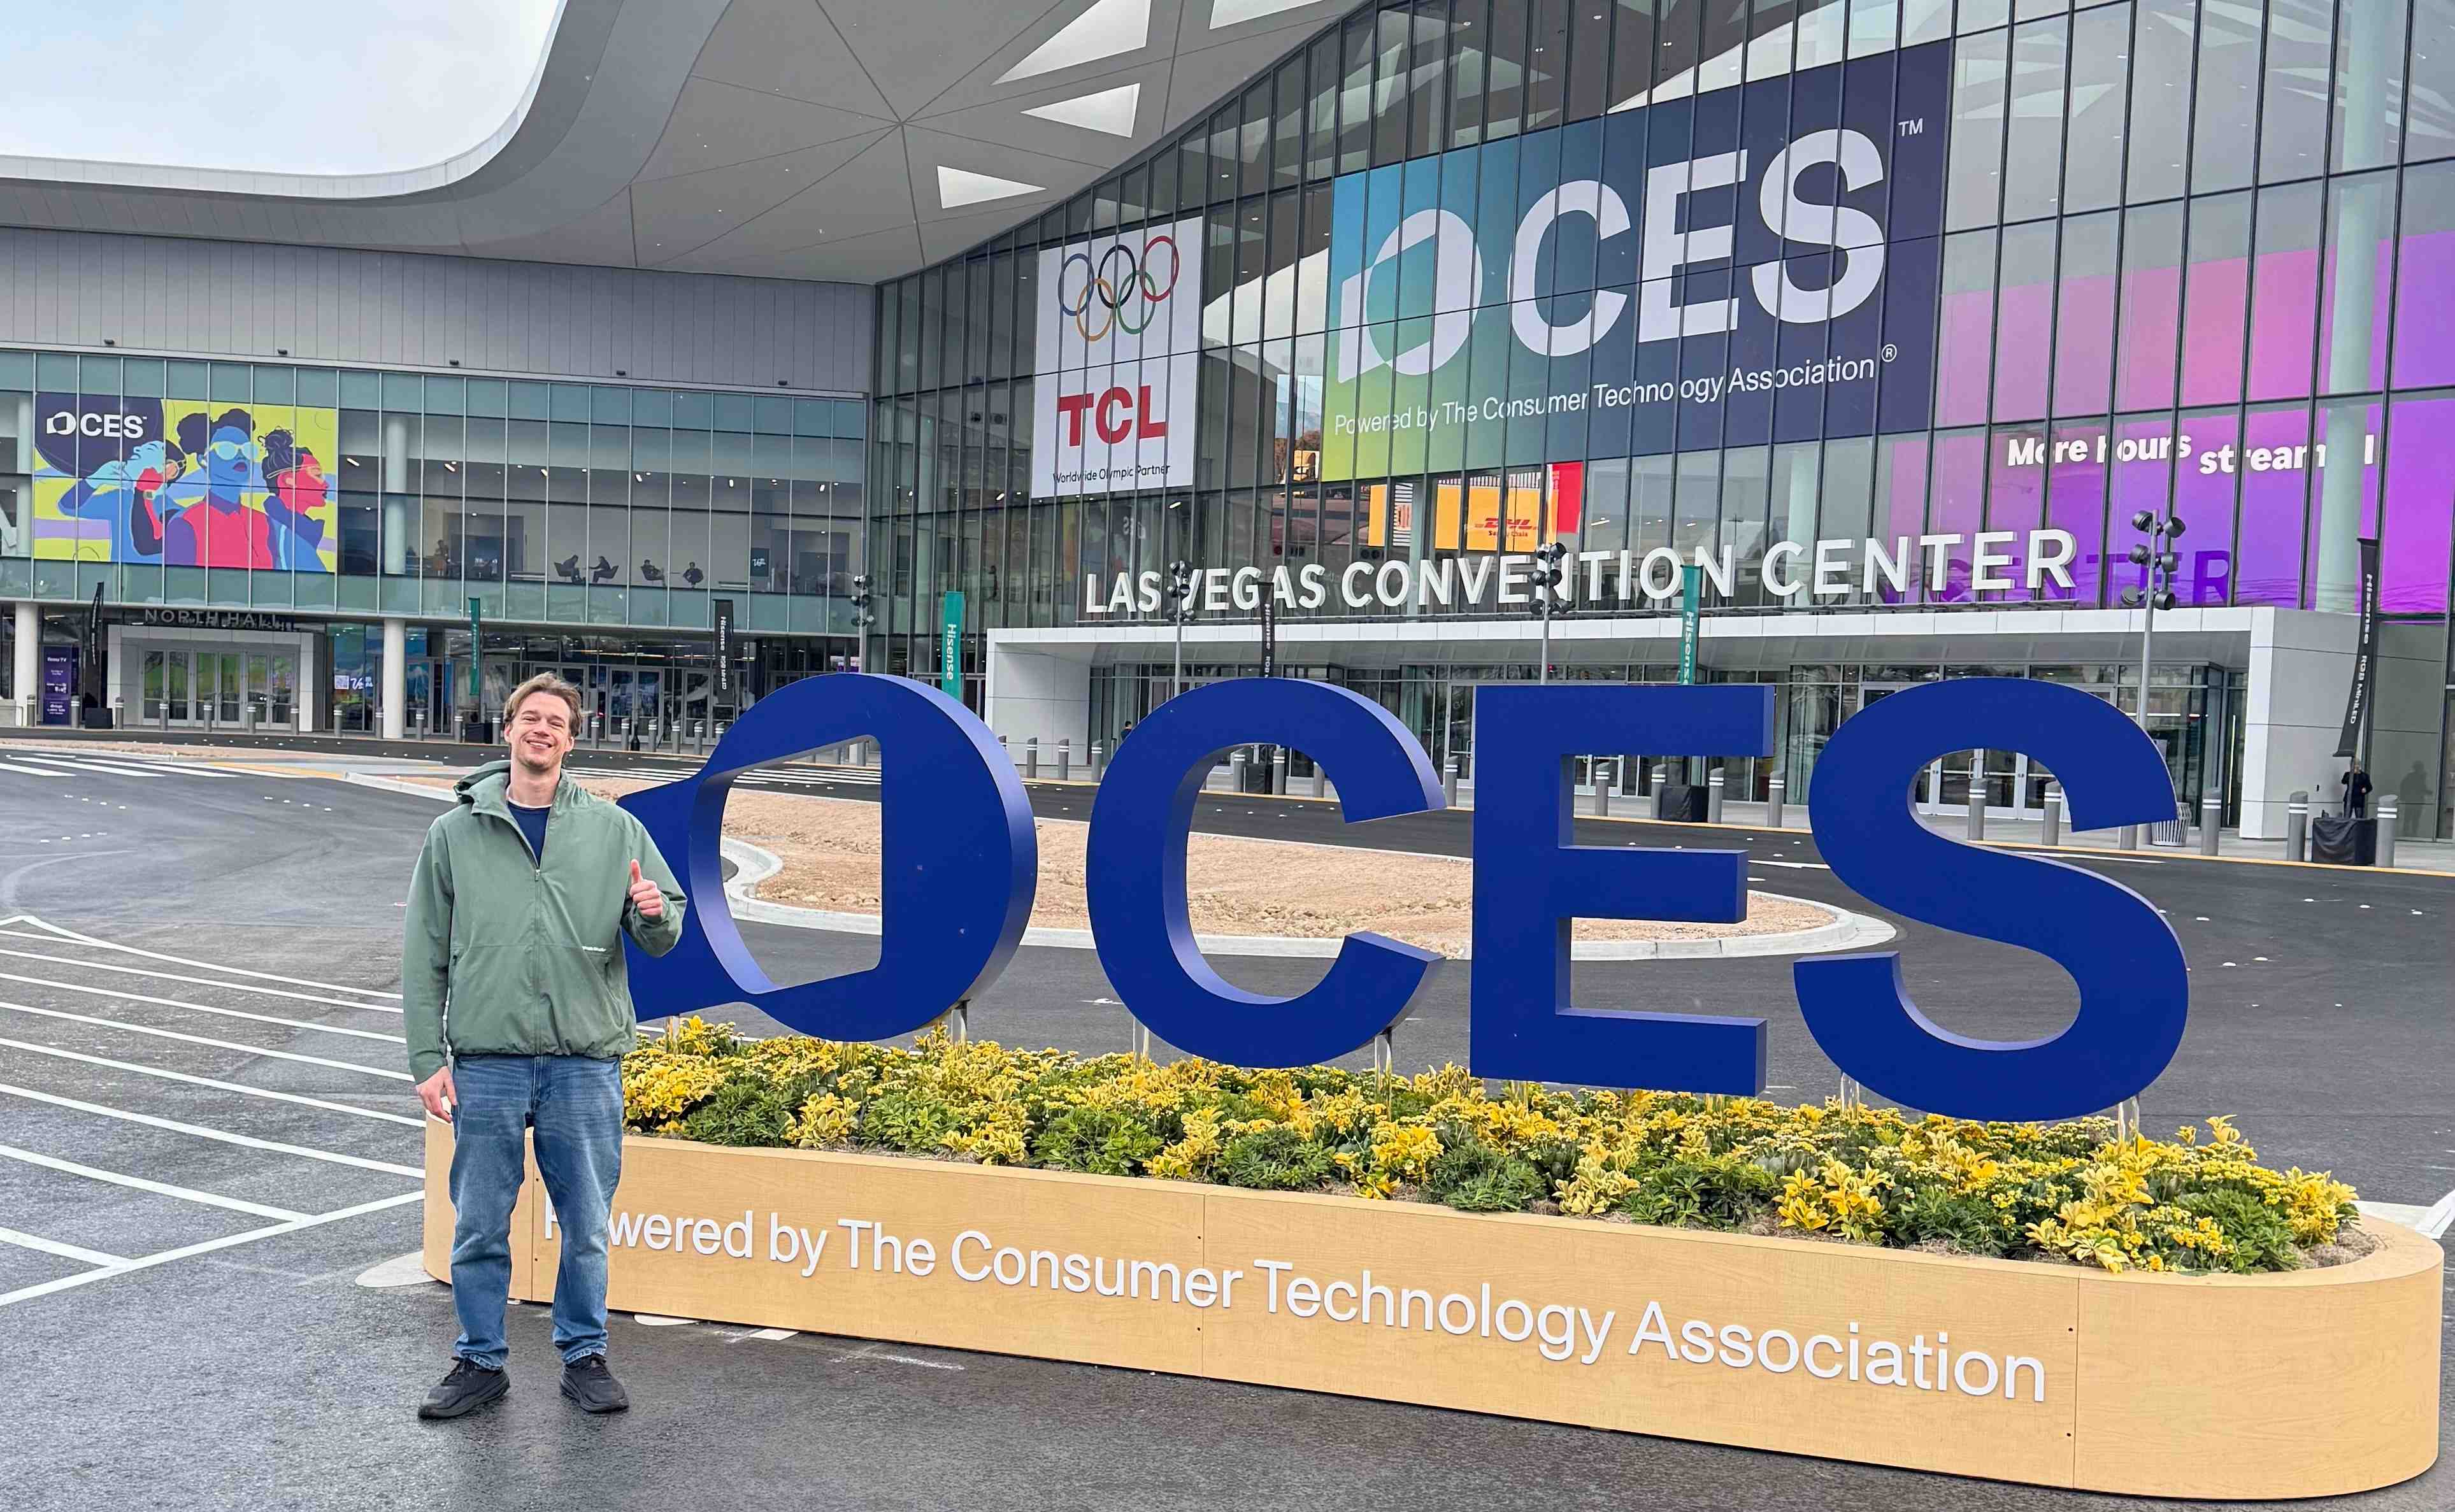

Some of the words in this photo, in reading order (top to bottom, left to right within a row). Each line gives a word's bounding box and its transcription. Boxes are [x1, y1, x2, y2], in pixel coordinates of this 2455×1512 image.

[1058, 385, 1168, 447] TCL
[1335, 406, 1411, 436] Powered
[1417, 404, 1438, 432] by
[1442, 401, 1478, 425] The
[1483, 392, 1587, 420] Consumer
[1593, 374, 1724, 408] Technoogy
[1727, 355, 1875, 394] Association
[1053, 470, 1098, 483] Worldwide
[1099, 465, 1134, 481] Olympic
[1136, 464, 1171, 476] Partner
[1085, 571, 1162, 613] LAS
[1175, 564, 1326, 611] VEGAS
[1341, 545, 1735, 608] CONVENTION
[1761, 529, 2078, 597] CENTER
[145, 609, 218, 627] NORTH
[2364, 574, 2373, 645] Hisense
[947, 624, 956, 680] Hisense
[1684, 611, 1694, 685] Hisens
[1086, 676, 2189, 1122] CES
[545, 1192, 753, 1259] Pwered
[769, 1212, 827, 1278] by
[838, 1218, 936, 1276] The
[951, 1230, 1243, 1308] Consumer
[1254, 1259, 1615, 1365] Technology
[1628, 1301, 2045, 1402] Association
